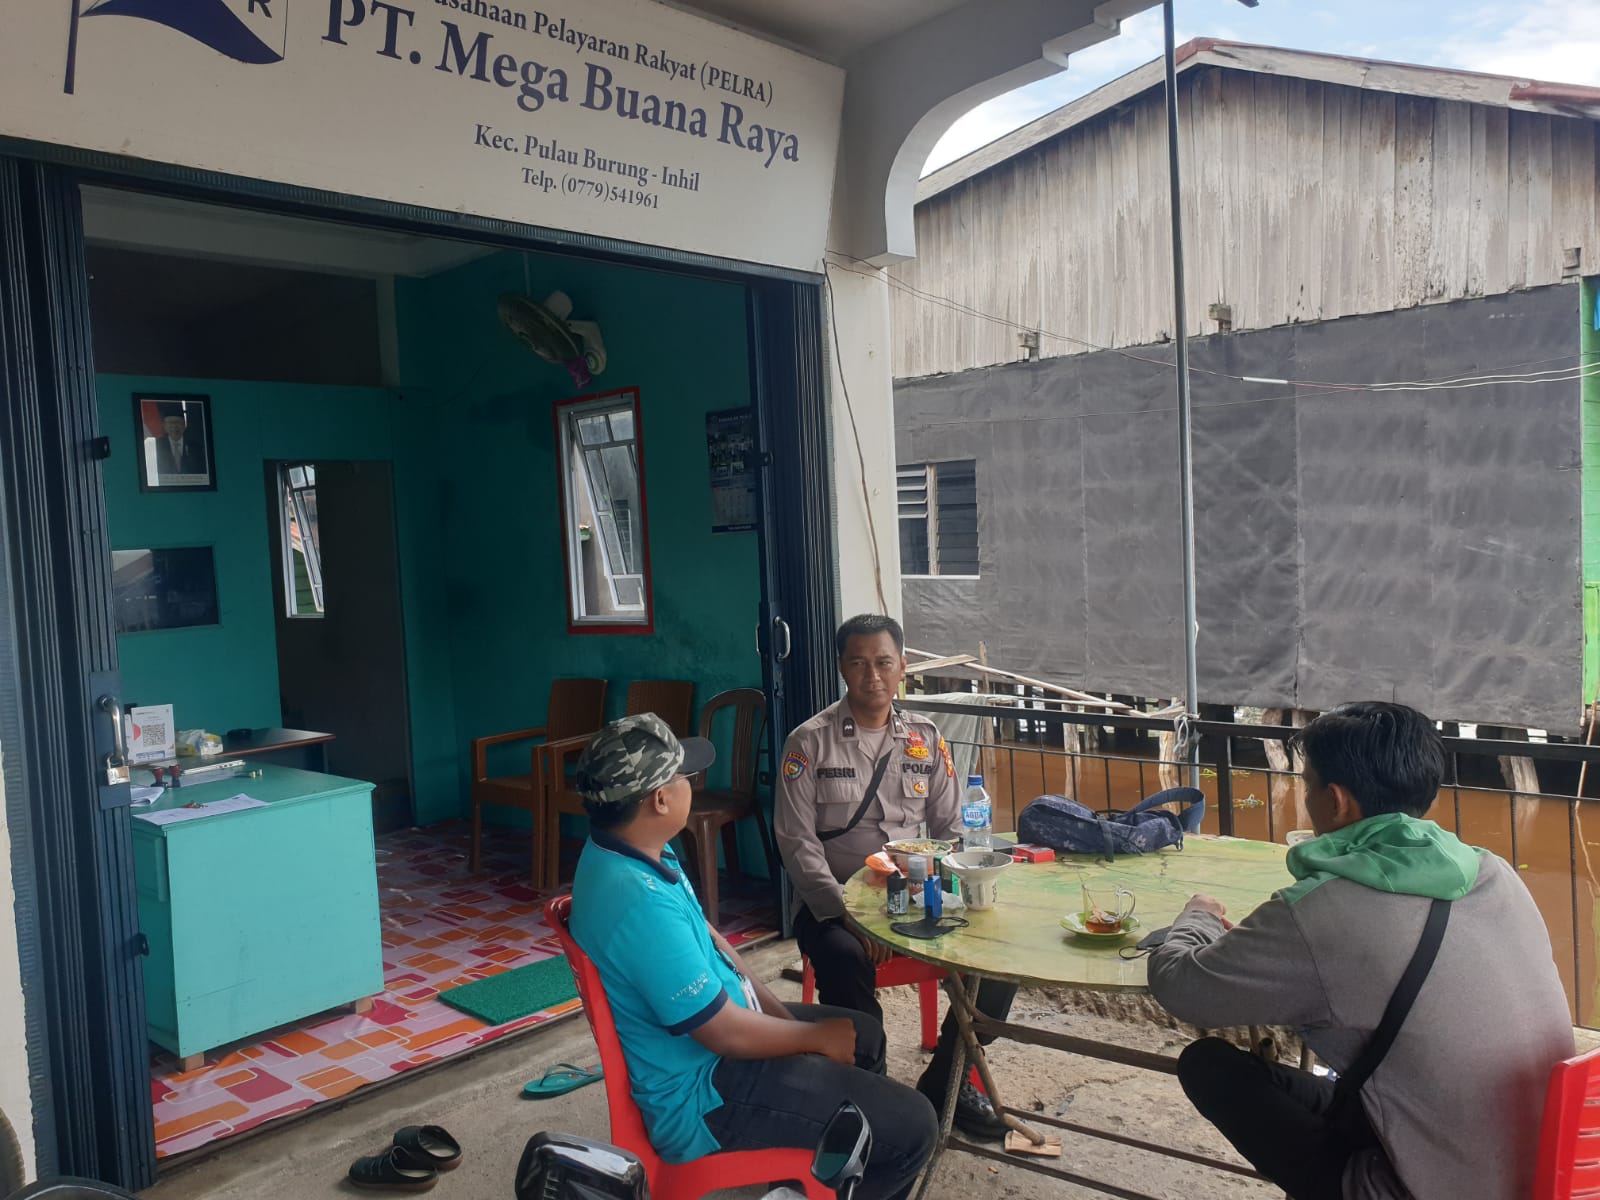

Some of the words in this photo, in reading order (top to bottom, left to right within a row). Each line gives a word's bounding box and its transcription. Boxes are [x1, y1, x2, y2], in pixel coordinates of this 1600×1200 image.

[321, 0, 422, 65] PT.
[434, 20, 569, 112] Mega
[579, 62, 708, 138] Buana
[716, 101, 800, 169] Raya
[532, 10, 629, 61] Pelayaran
[634, 43, 697, 81] Rakyat
[700, 61, 773, 108] (PELRA)
[474, 123, 519, 153] Kec.
[524, 134, 579, 165] Pulau
[582, 148, 648, 186] Burung
[660, 166, 700, 192] Inhil
[521, 167, 558, 193] Telp.
[561, 172, 659, 209] (0779)541961
